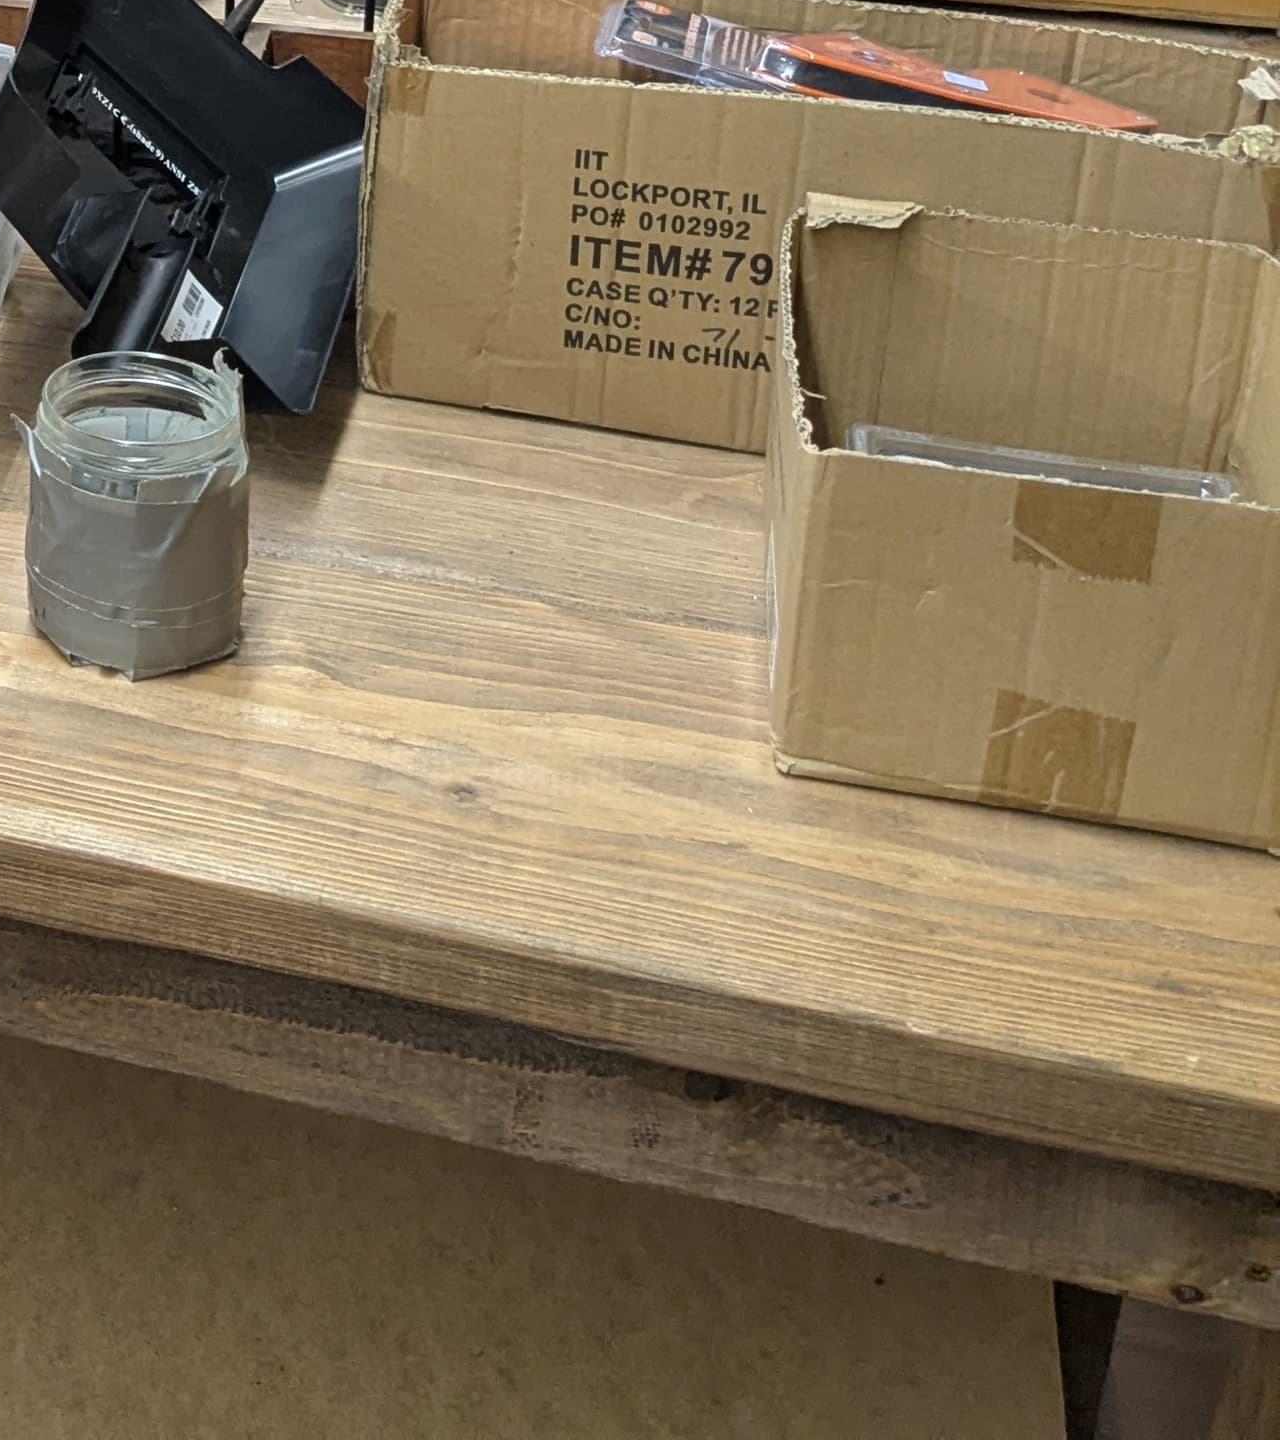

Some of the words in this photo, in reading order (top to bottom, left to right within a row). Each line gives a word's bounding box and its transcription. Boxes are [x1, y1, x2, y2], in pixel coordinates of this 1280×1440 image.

[574, 148, 609, 171] IIT
[572, 176, 735, 216] LOCKPORT,
[741, 192, 768, 216] IL
[570, 203, 626, 229] PO#
[638, 210, 752, 242] 0102992
[569, 233, 713, 281] ITEM#
[564, 302, 641, 330] C/NO:
[565, 276, 641, 304] CASE
[647, 286, 721, 314] Q'TY:
[728, 296, 761, 318] 12
[563, 329, 641, 357] MADE
[647, 339, 676, 361] IN
[682, 343, 772, 374] CHINA
